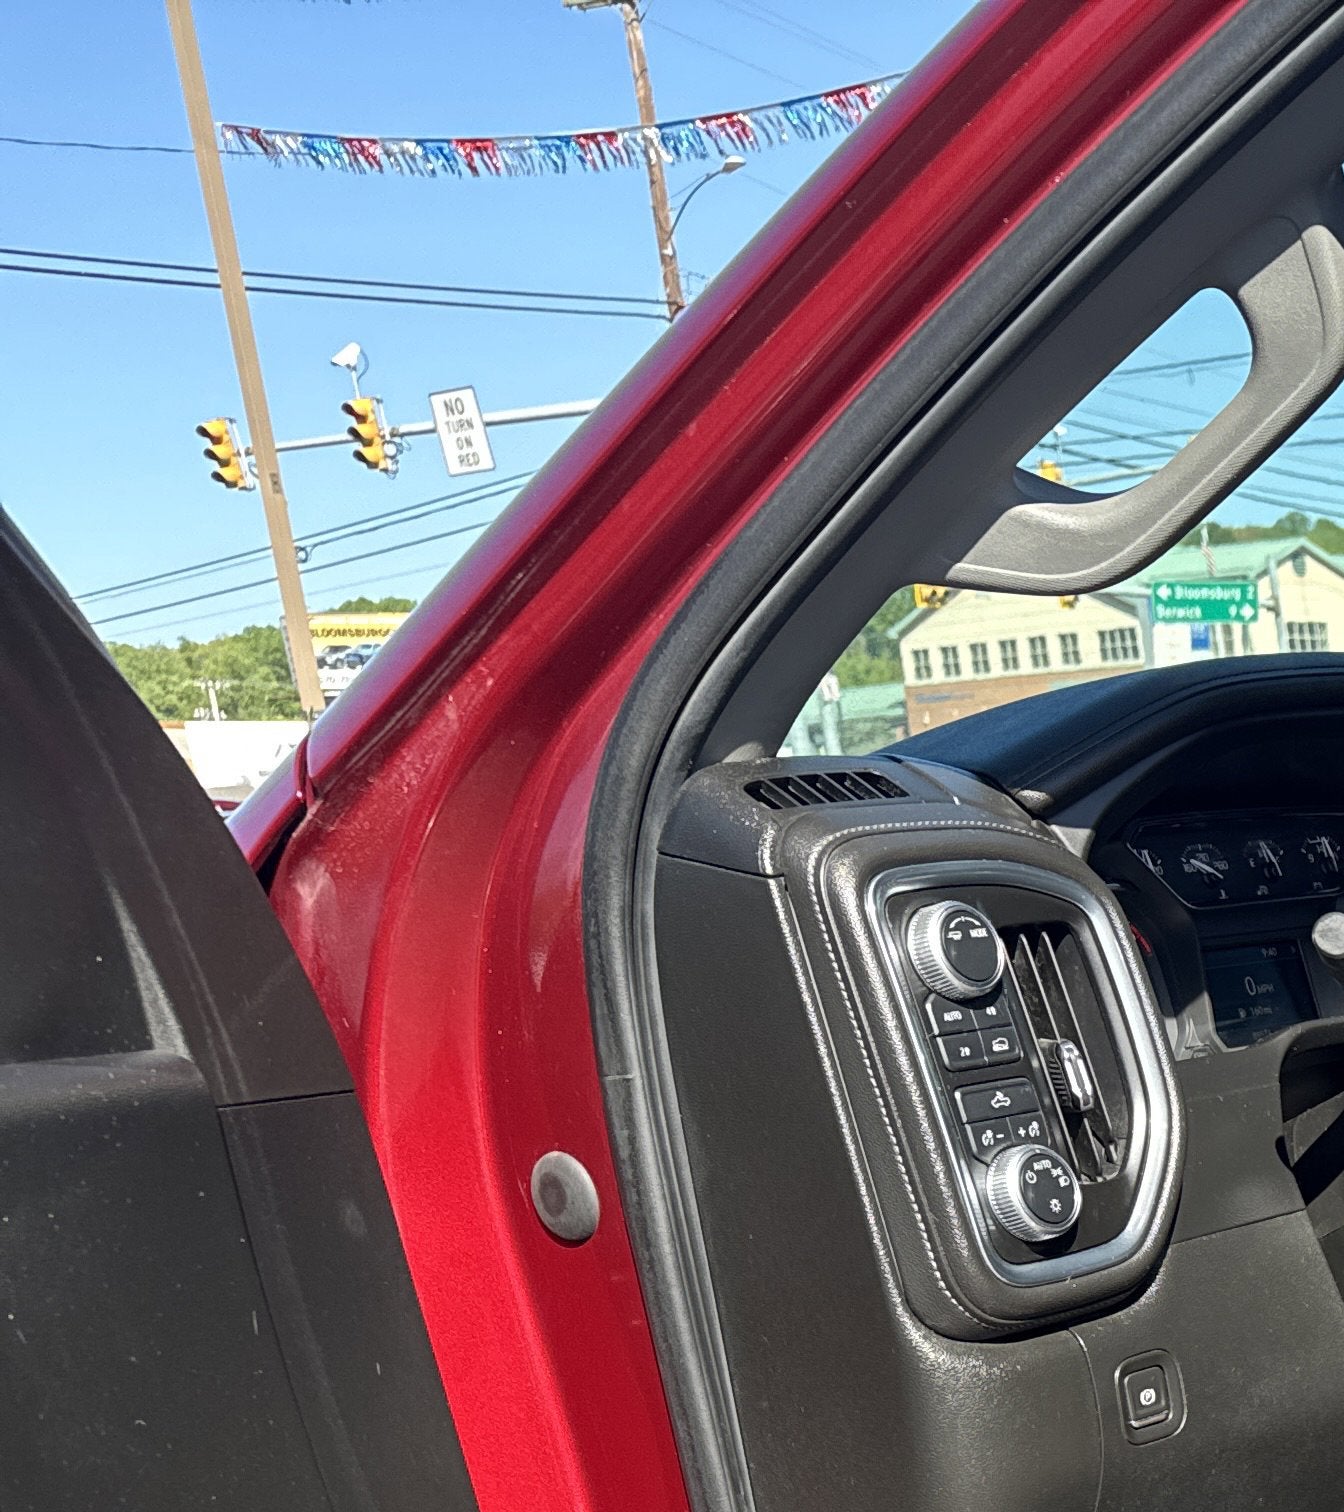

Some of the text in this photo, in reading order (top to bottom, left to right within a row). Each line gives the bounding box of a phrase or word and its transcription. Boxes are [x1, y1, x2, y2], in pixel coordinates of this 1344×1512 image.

[443, 397, 465, 417] NO
[444, 417, 475, 434] TURN
[456, 435, 473, 450] ON
[457, 451, 480, 467] RED
[1174, 585, 1241, 601] Bloomsburg
[1156, 603, 1202, 618] Berwick
[969, 927, 989, 938] MODE
[1244, 976, 1256, 996] 0
[943, 1010, 963, 1022] AUTO
[1033, 1159, 1052, 1171] AUTO
